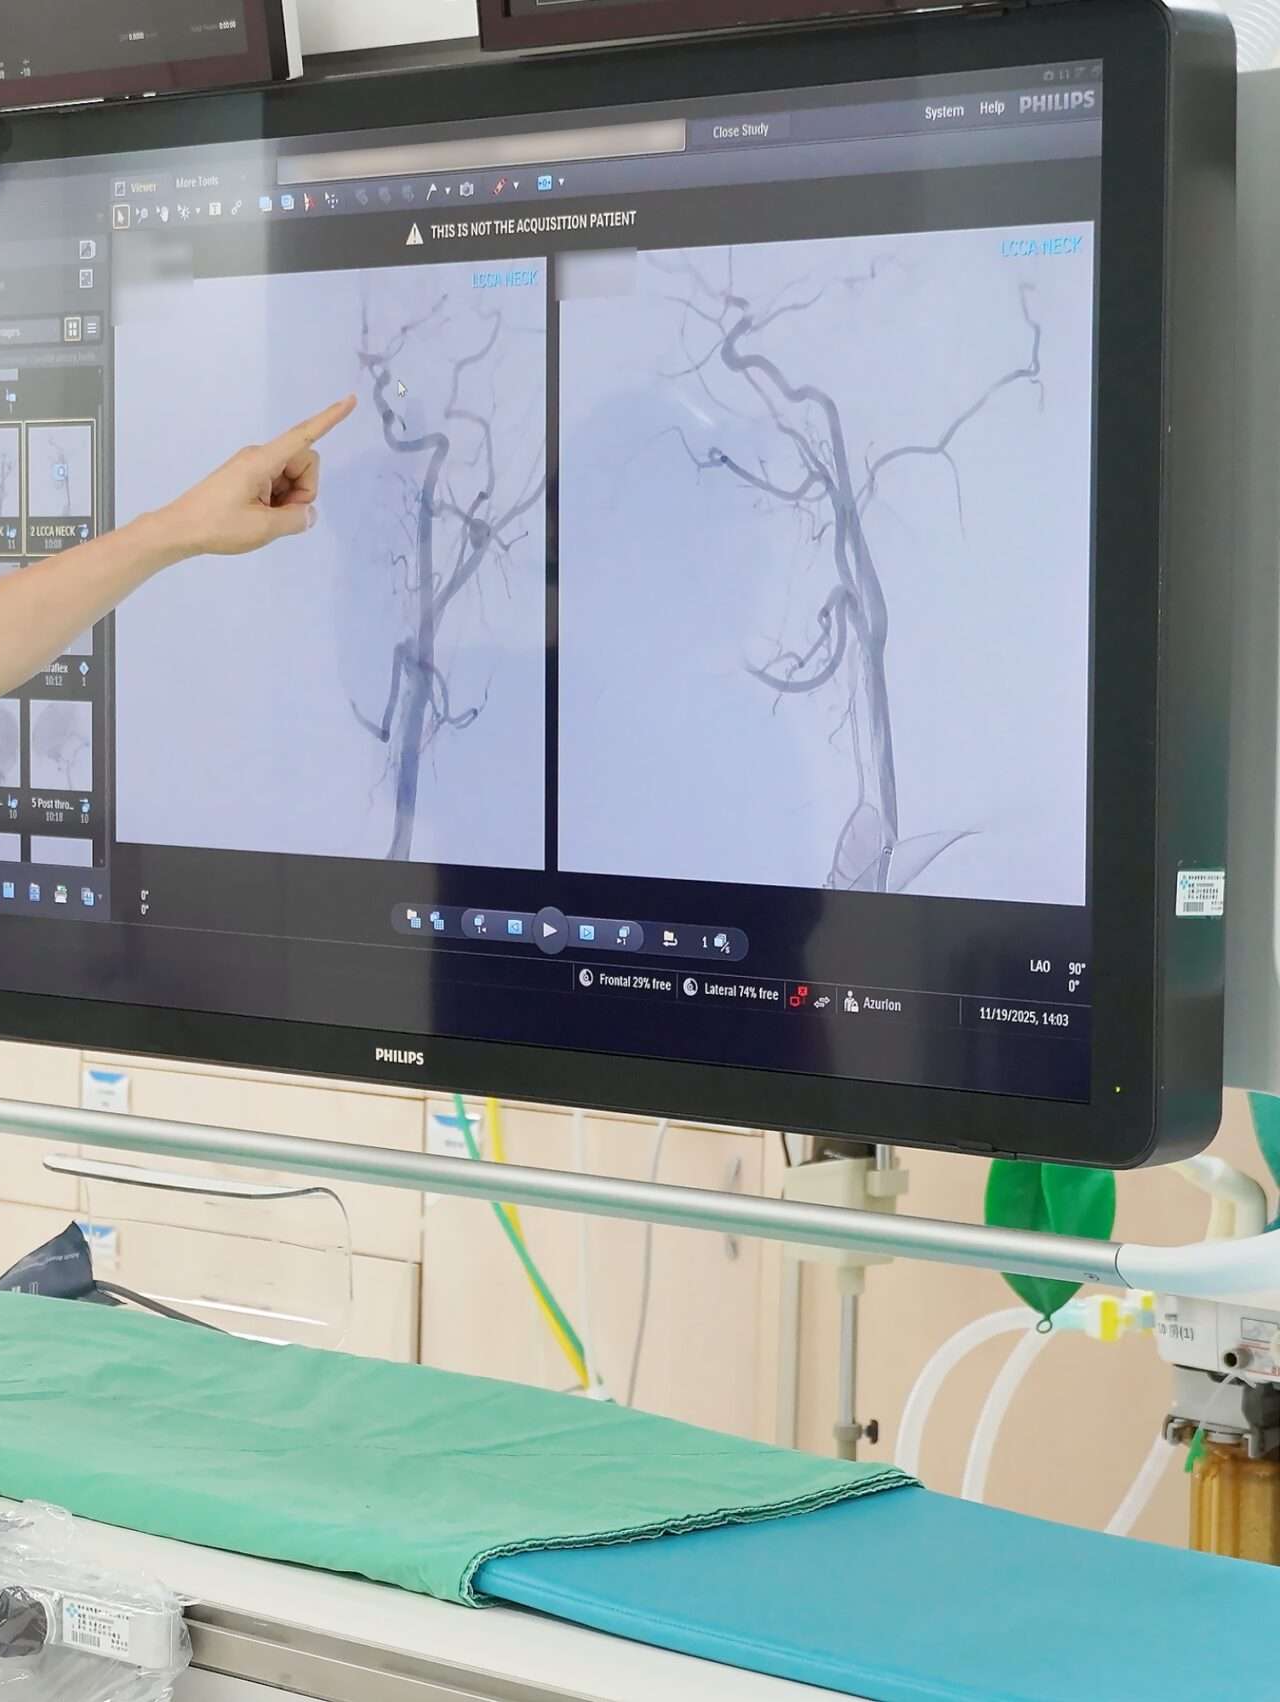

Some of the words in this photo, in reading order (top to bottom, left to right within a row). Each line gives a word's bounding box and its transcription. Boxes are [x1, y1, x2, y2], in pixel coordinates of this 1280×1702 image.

[925, 105, 965, 121] System
[980, 100, 1005, 116] Help
[1020, 90, 1095, 114] PHILIPS
[713, 125, 740, 139] Close
[742, 122, 769, 137] Study
[176, 177, 197, 189] More
[198, 175, 219, 187] Tools
[431, 224, 455, 239] THIS
[457, 223, 468, 237] IS
[471, 221, 492, 236] NOT
[494, 219, 515, 234] THE
[517, 214, 587, 234] ACQUISITION
[590, 210, 637, 227] PATIENT
[1040, 234, 1083, 256] NECK
[505, 270, 538, 287] NECK
[30, 526, 36, 537] 2
[36, 525, 55, 537] LCCA
[55, 525, 76, 537] NECK
[31, 798, 37, 808] 5
[38, 798, 52, 809] Post
[141, 889, 149, 901] 0°
[141, 904, 149, 915] 0°
[1030, 959, 1051, 973] LAO
[1068, 962, 1086, 976] 90°
[599, 973, 631, 988] Frontal
[632, 975, 651, 989] 29%
[652, 977, 672, 991] free
[1068, 979, 1080, 993] 0°
[704, 982, 736, 997] Lateral
[738, 985, 757, 999] 74%
[758, 986, 779, 1000] free
[863, 997, 901, 1012] Azurion
[979, 1006, 1039, 1026] 11/19/2025,
[1042, 1011, 1069, 1027] 14:03
[375, 1047, 425, 1066] PHILIPS
